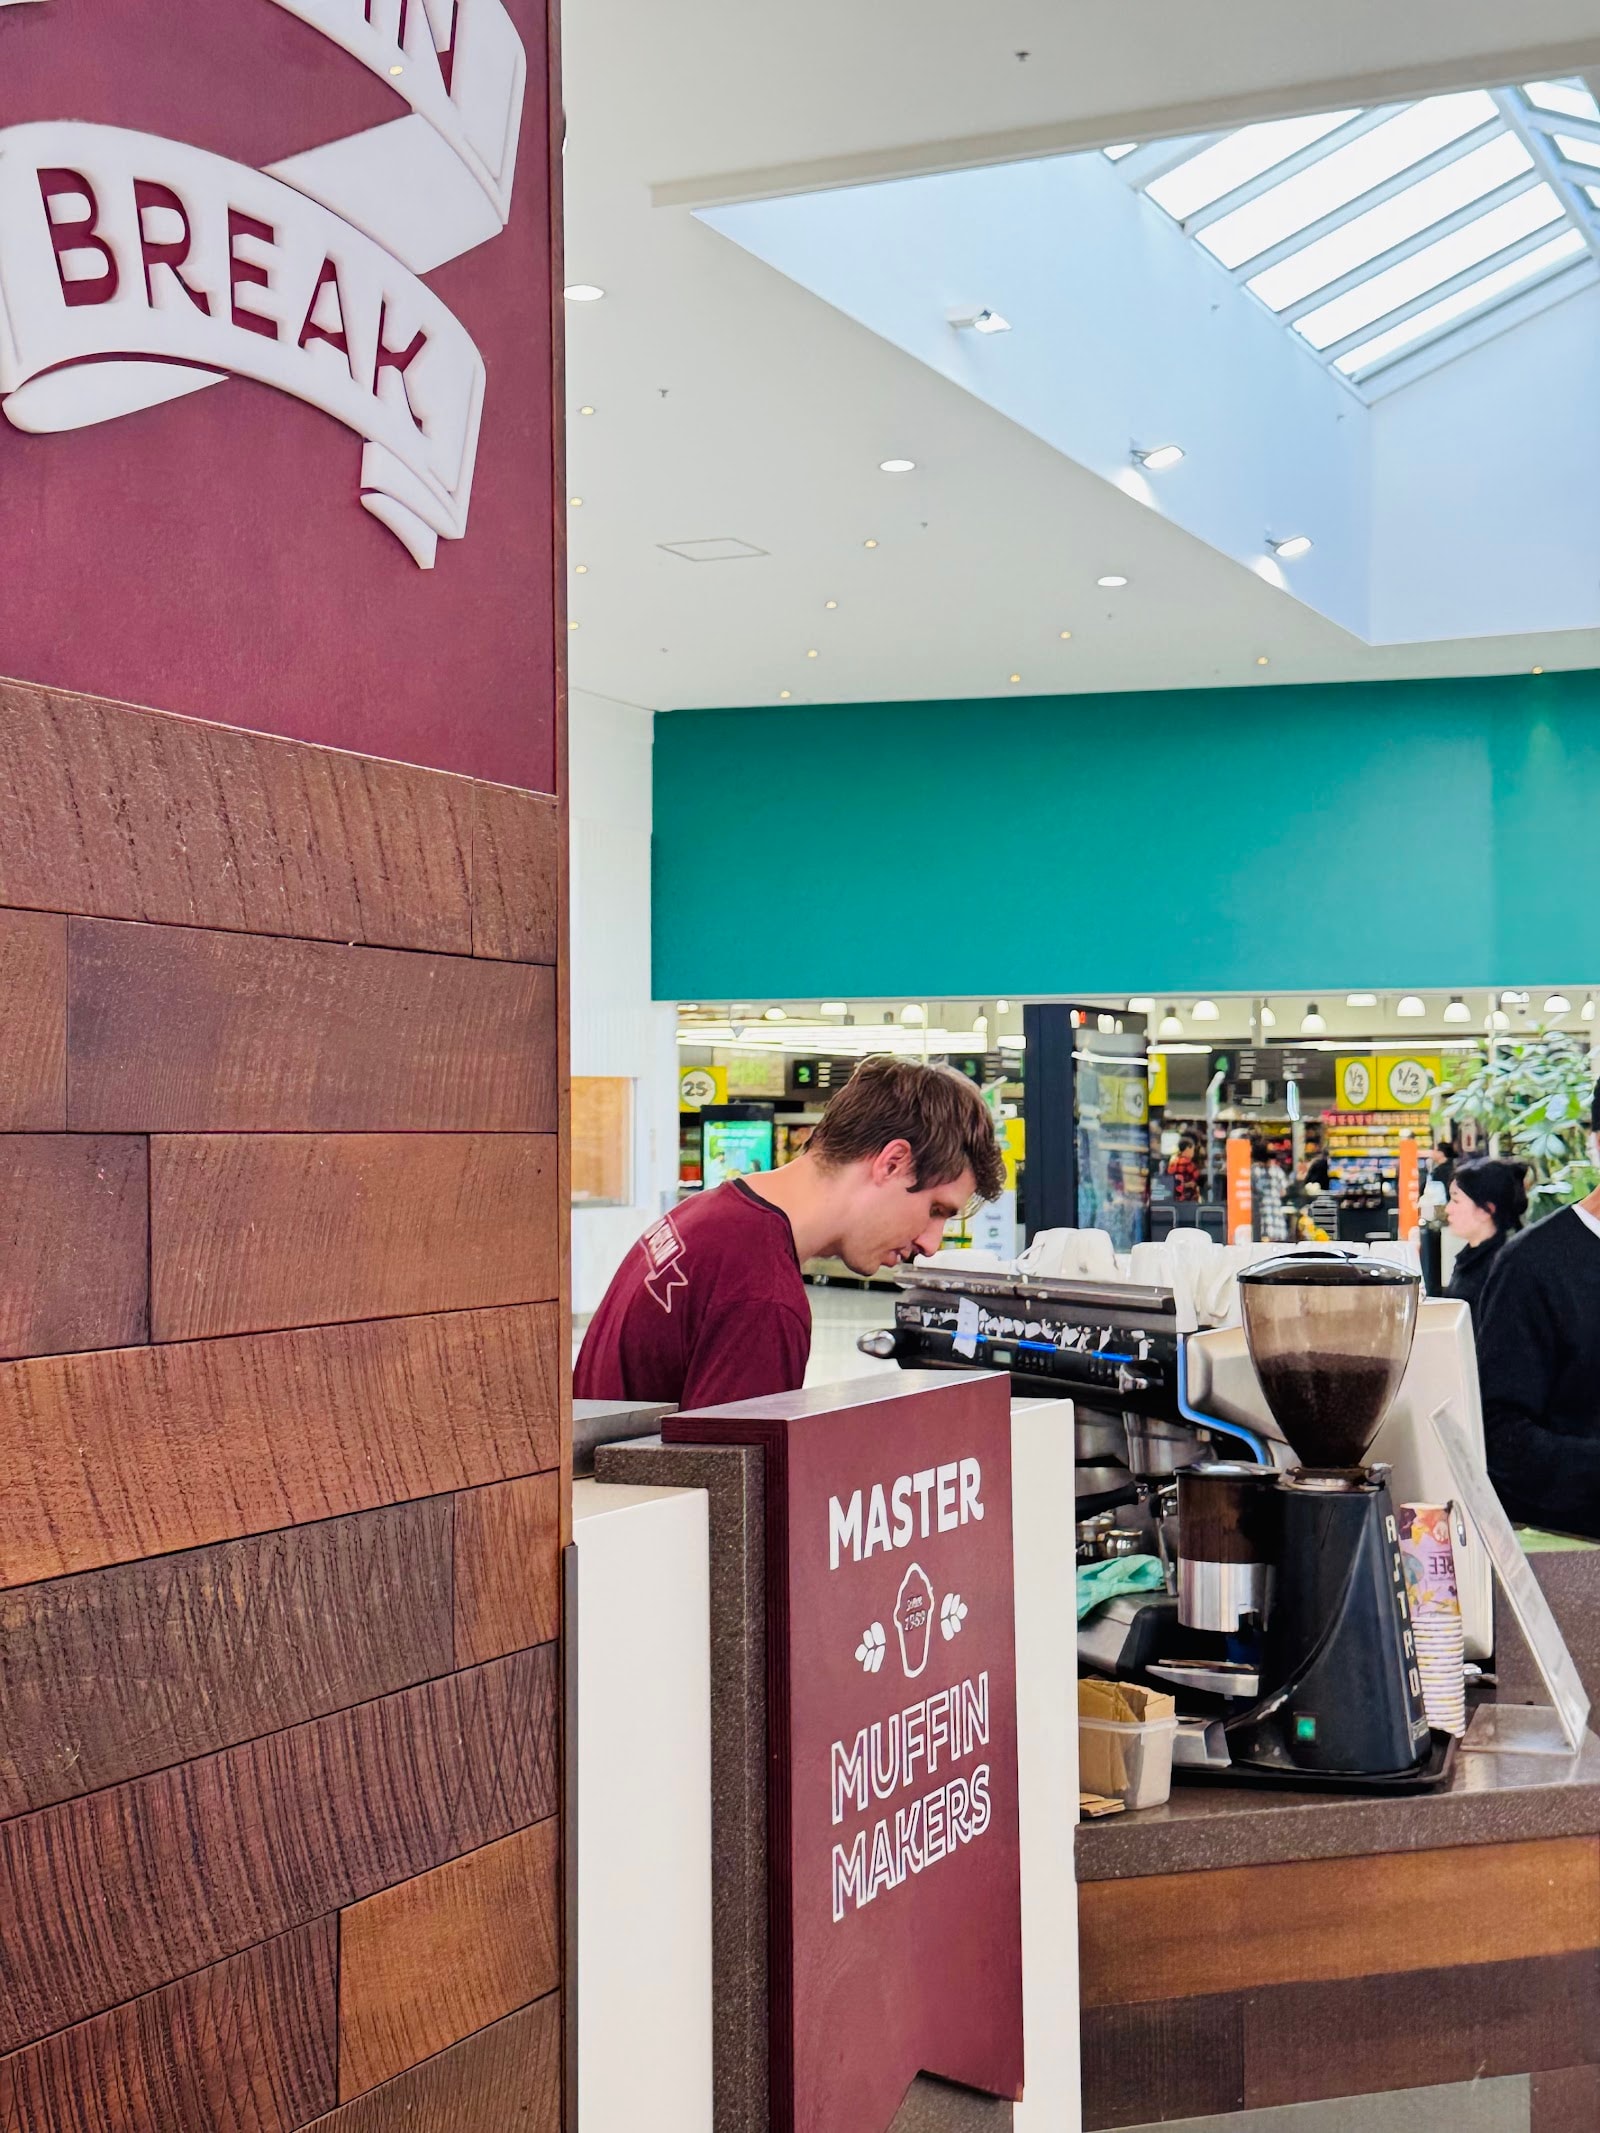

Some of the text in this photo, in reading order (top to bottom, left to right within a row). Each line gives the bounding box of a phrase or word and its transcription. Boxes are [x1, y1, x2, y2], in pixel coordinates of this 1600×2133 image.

[37, 168, 428, 429] BREAK
[797, 1066, 811, 1083] 2
[829, 1457, 985, 1570] MASTER
[1385, 1515, 1420, 1698] ASTRO
[831, 1671, 990, 1824] MUFFIN
[831, 1763, 991, 1923] MAKERS
